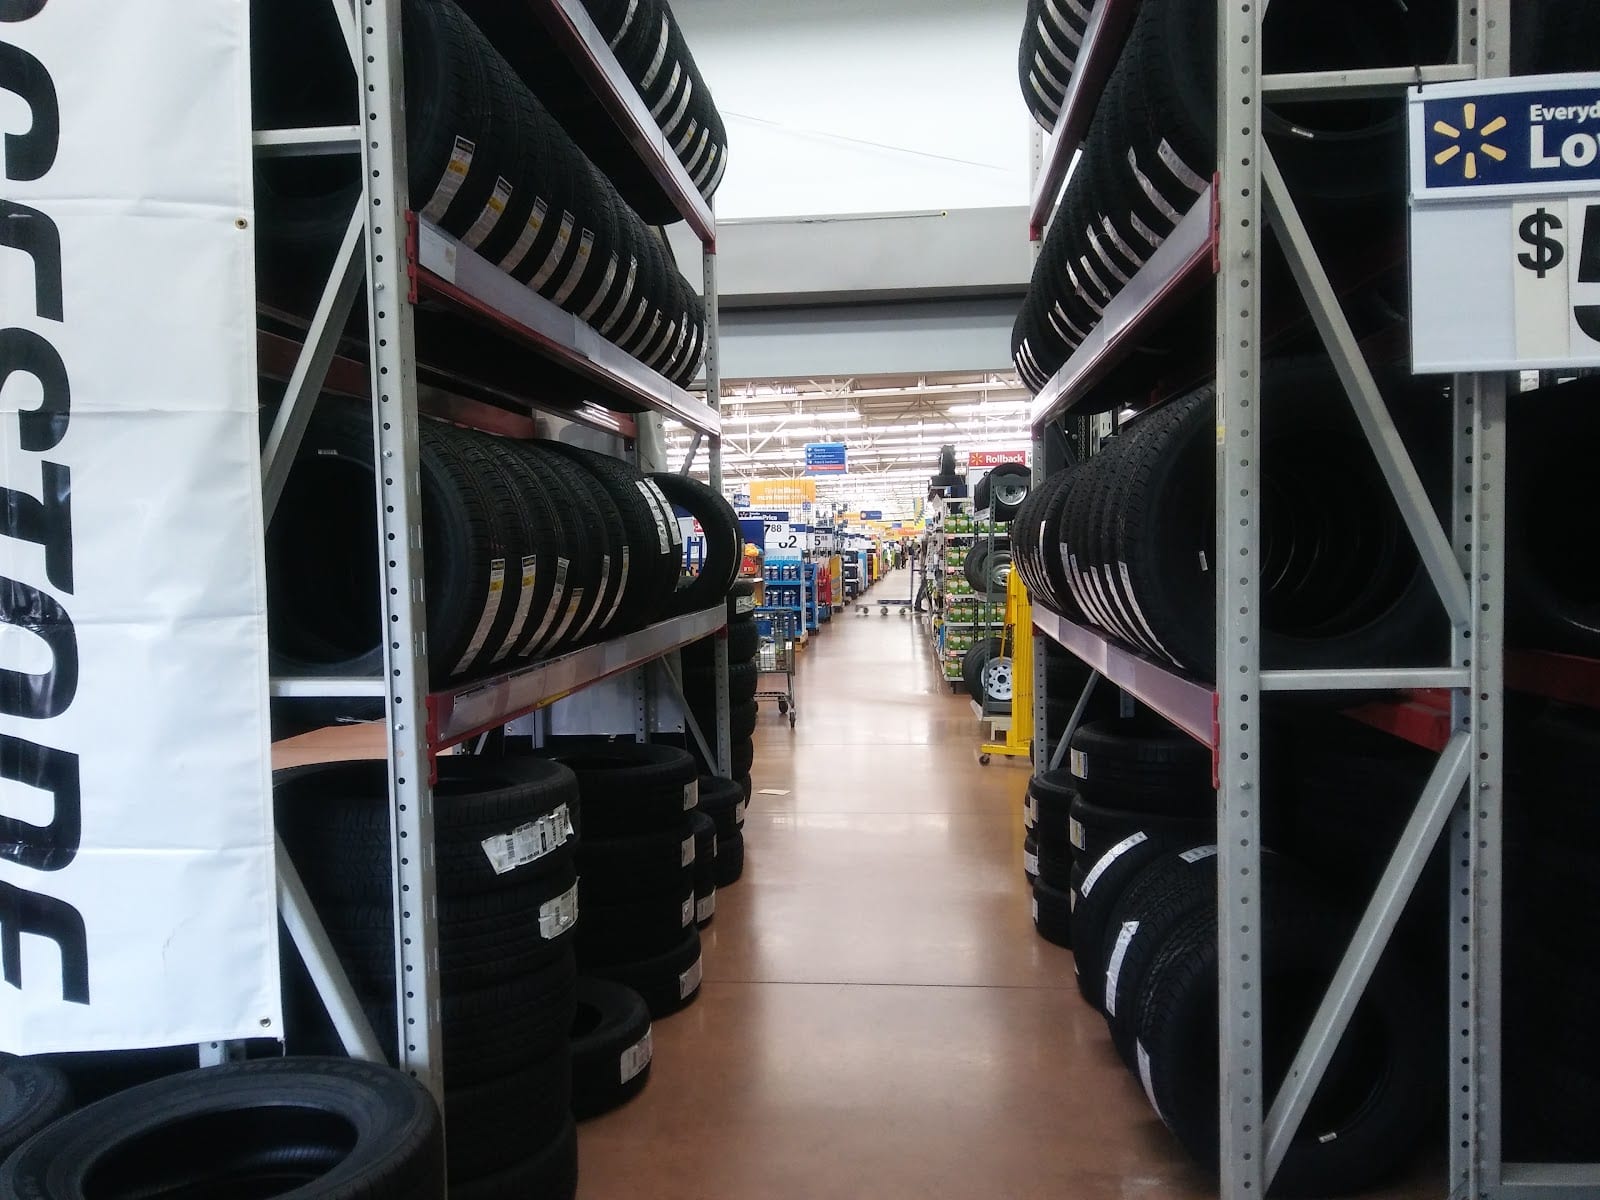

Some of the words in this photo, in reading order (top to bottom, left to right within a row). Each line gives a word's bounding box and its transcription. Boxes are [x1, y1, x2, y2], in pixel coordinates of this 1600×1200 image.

[1530, 100, 1600, 124] Everyd
[1530, 124, 1600, 169] Lo
[985, 454, 1024, 464] Rollback
